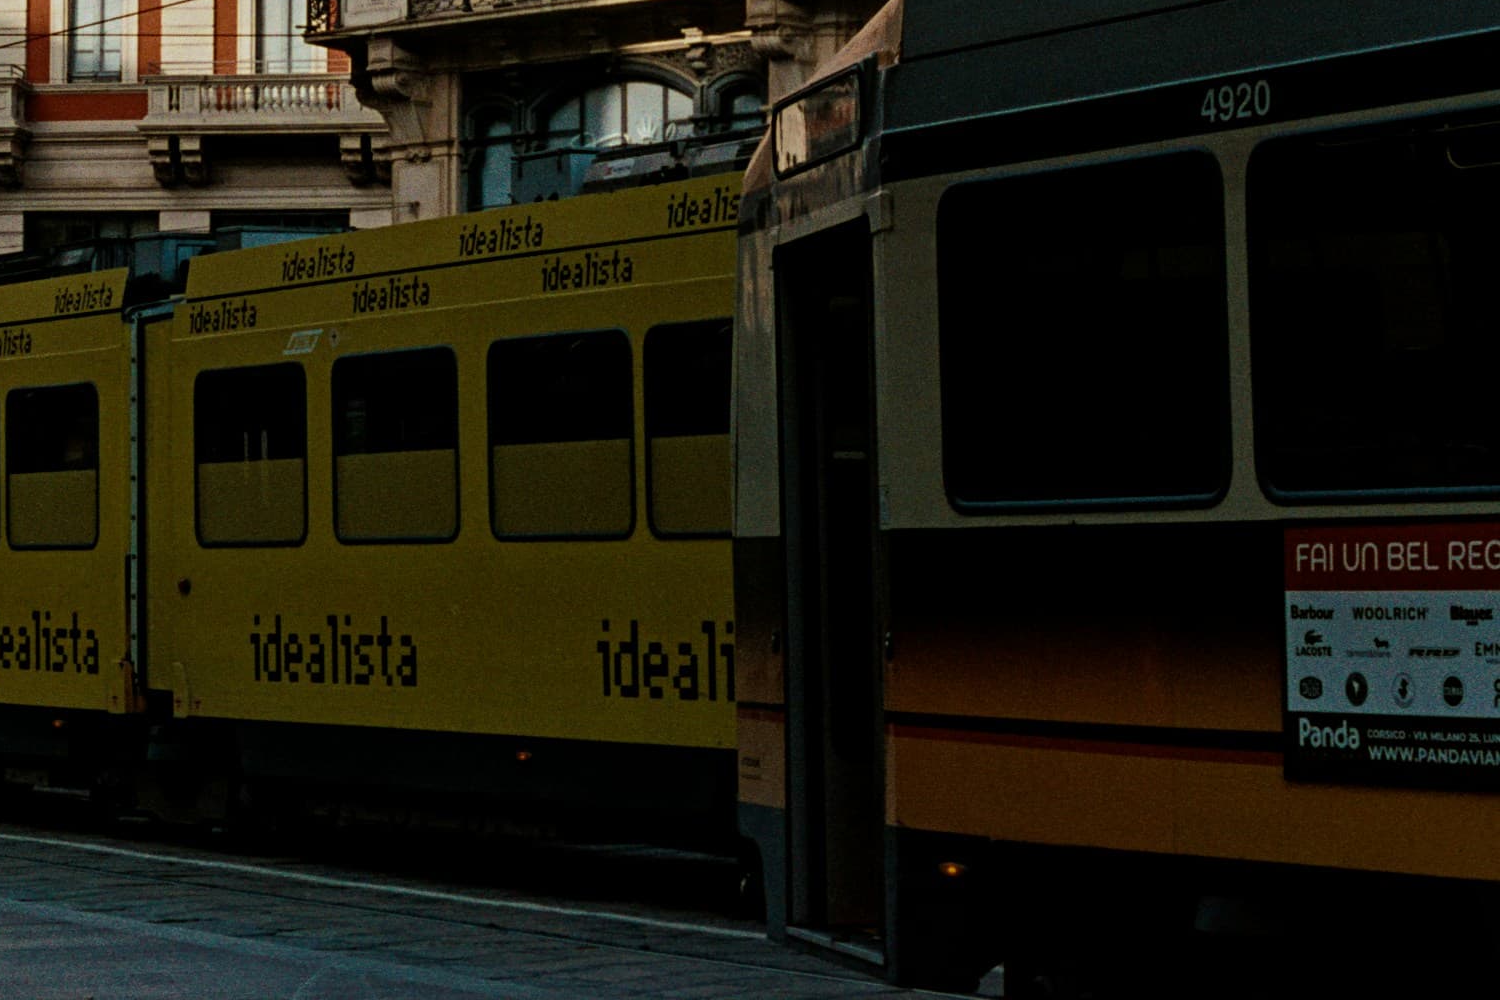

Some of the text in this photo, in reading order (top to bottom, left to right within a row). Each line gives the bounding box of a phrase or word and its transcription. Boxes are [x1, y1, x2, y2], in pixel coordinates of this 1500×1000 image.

[1200, 79, 1271, 123] 4920
[667, 185, 740, 229] idealis
[458, 216, 544, 257] idealista
[281, 244, 356, 281] idealista
[541, 250, 633, 293] idealista
[53, 281, 113, 314] idealista
[351, 275, 431, 315] idealista
[188, 300, 258, 334] idealista
[1295, 542, 1334, 572] FAI
[1387, 540, 1440, 571] BEL
[1447, 539, 1500, 570] REG
[1290, 604, 1335, 620] Barbour
[1352, 606, 1426, 621] WOOLRICH
[250, 614, 418, 687] idealista
[598, 619, 735, 701] ideali
[1296, 646, 1332, 657] LACOSTE
[1298, 717, 1360, 750] Panda
[1367, 729, 1406, 740] CORSICO
[1413, 731, 1429, 742] VIA
[1430, 732, 1466, 743] MILANO
